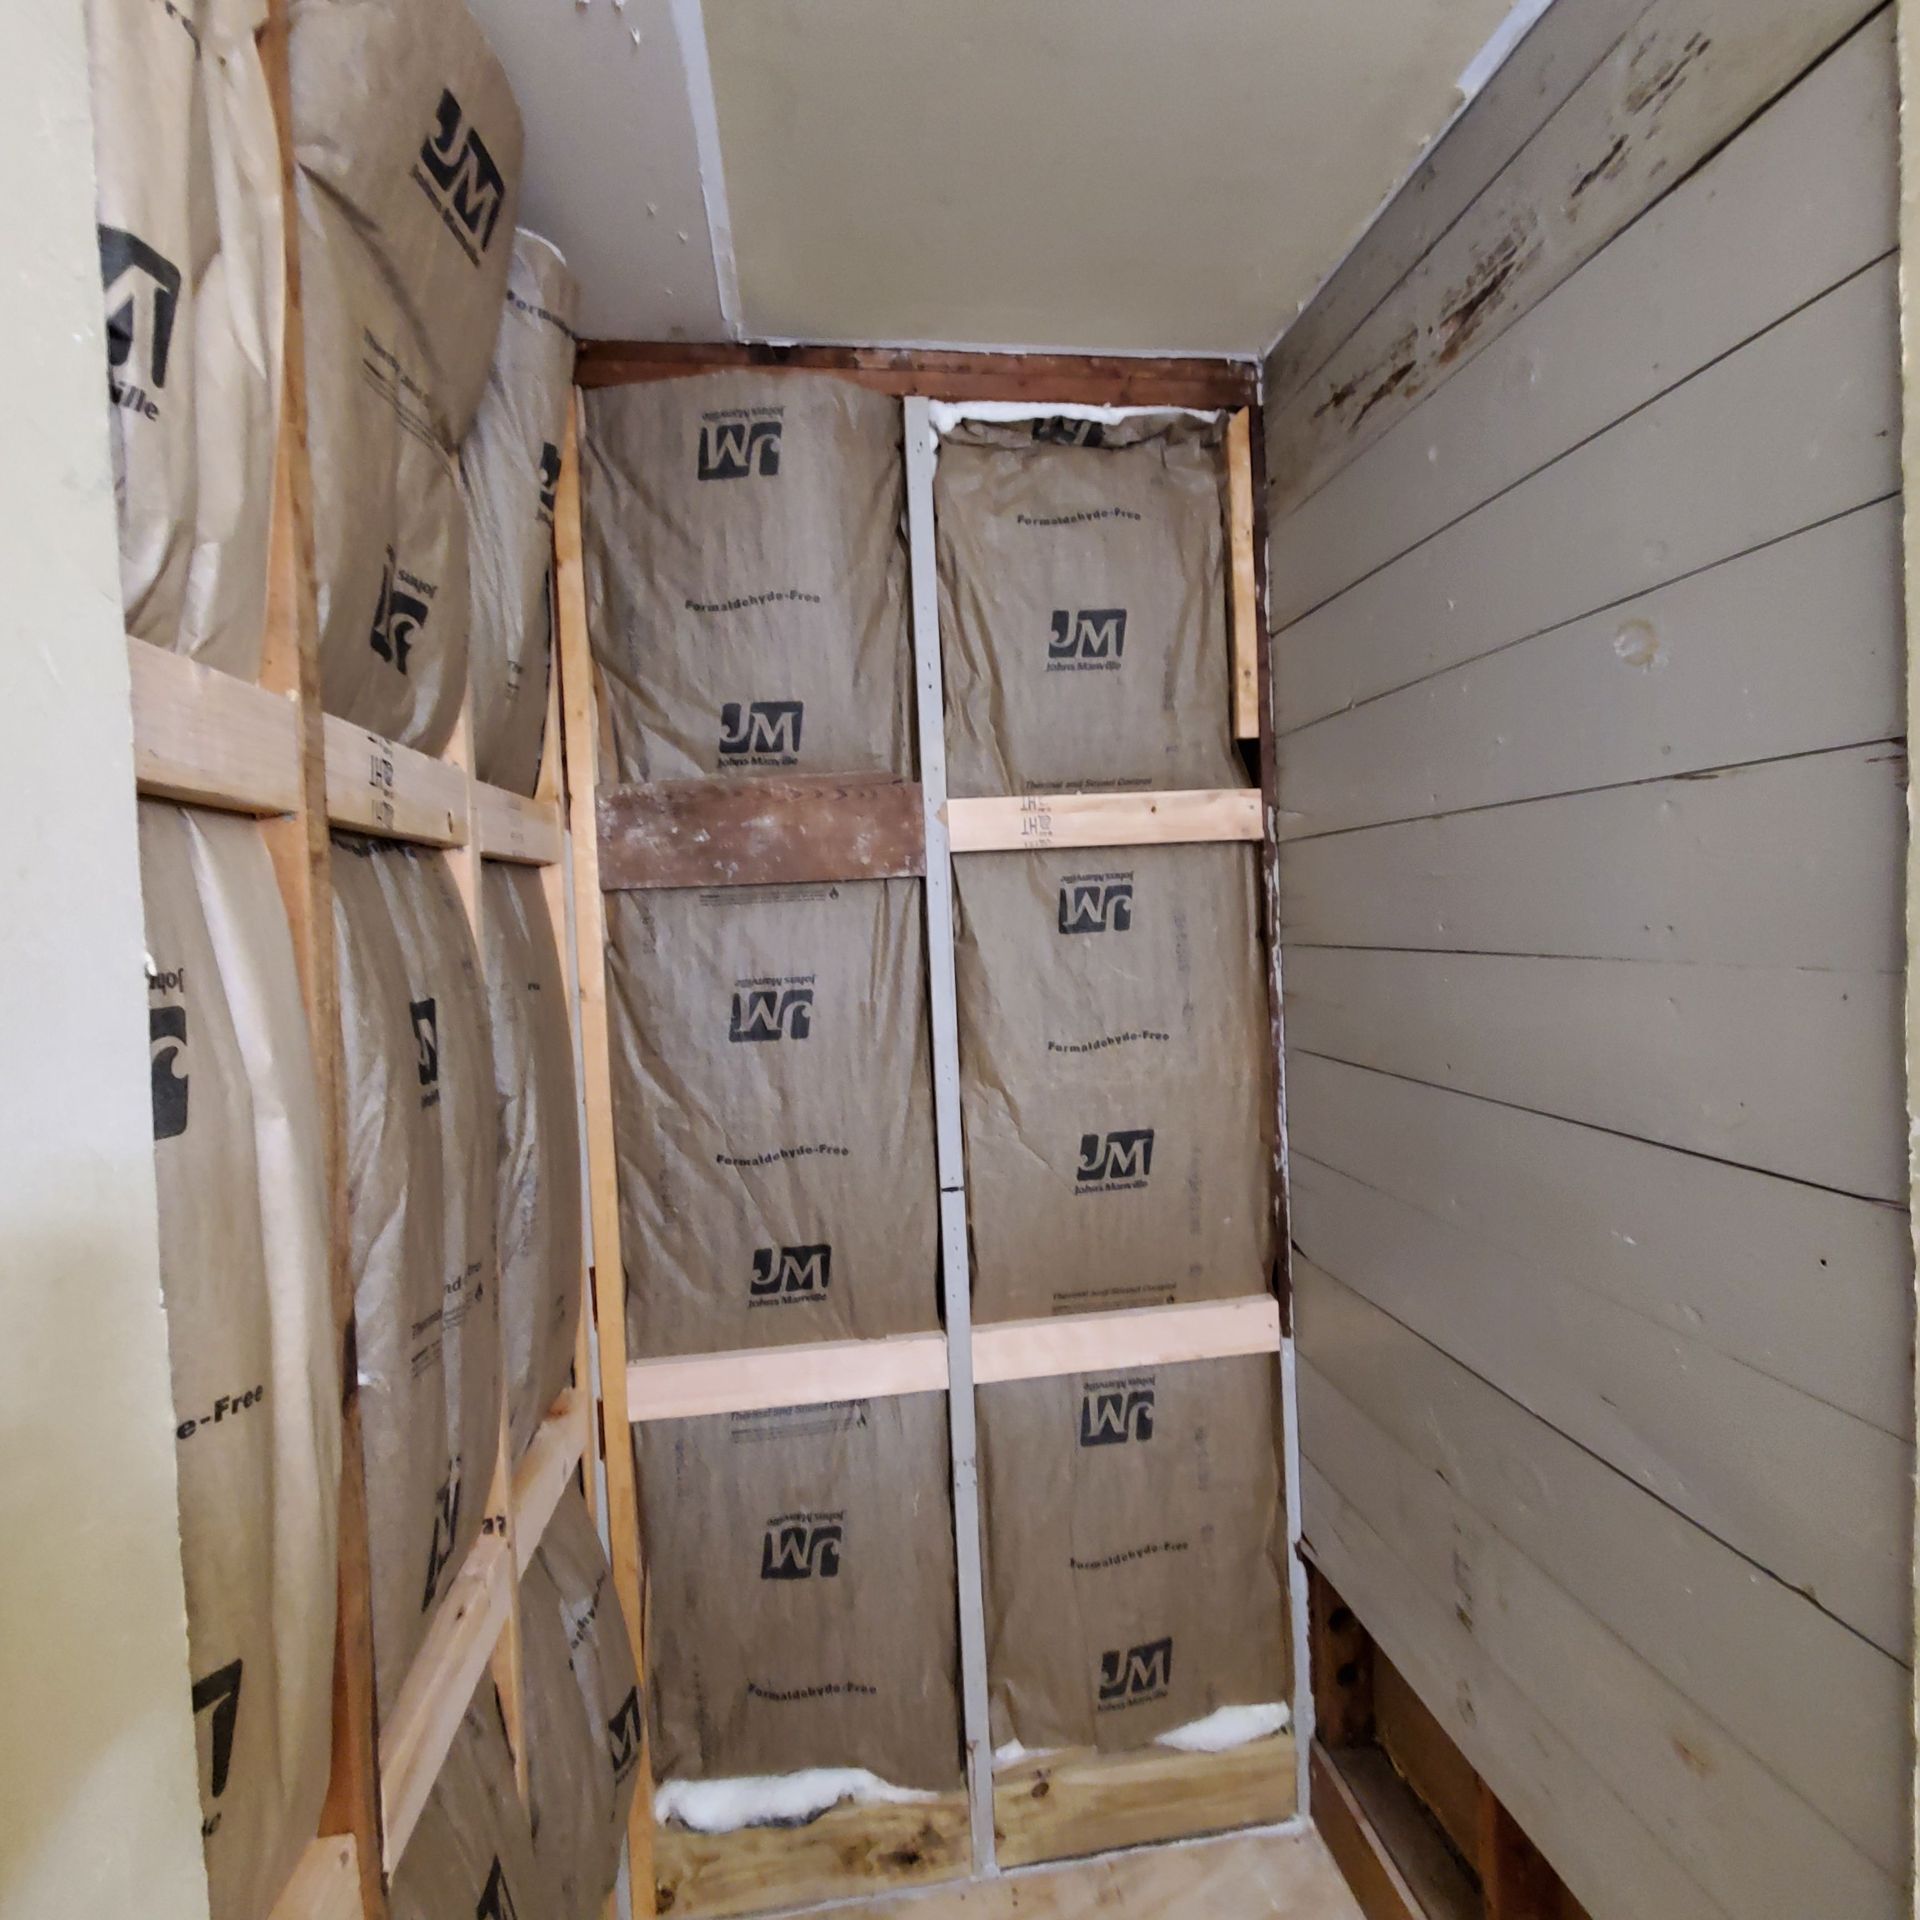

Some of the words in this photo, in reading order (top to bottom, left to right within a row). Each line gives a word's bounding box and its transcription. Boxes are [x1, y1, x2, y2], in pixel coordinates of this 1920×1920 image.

[420, 88, 505, 252] JM
[698, 422, 782, 480] JM
[1017, 507, 1141, 526] Formaldehyde-Free
[685, 590, 820, 613] Formaldehyde-Free
[1048, 609, 1127, 658] JM
[719, 701, 803, 753] JM
[1058, 885, 1133, 934] JM
[729, 989, 814, 1042] JM
[1049, 1030, 1169, 1052] Formaldehyde-Free
[716, 1144, 849, 1166] Formaldehyde-Free
[1077, 1129, 1154, 1181] JM
[750, 1244, 832, 1295] JM
[1080, 1391, 1154, 1447] JM
[761, 1526, 842, 1580] JM
[1099, 1636, 1172, 1700] JM
